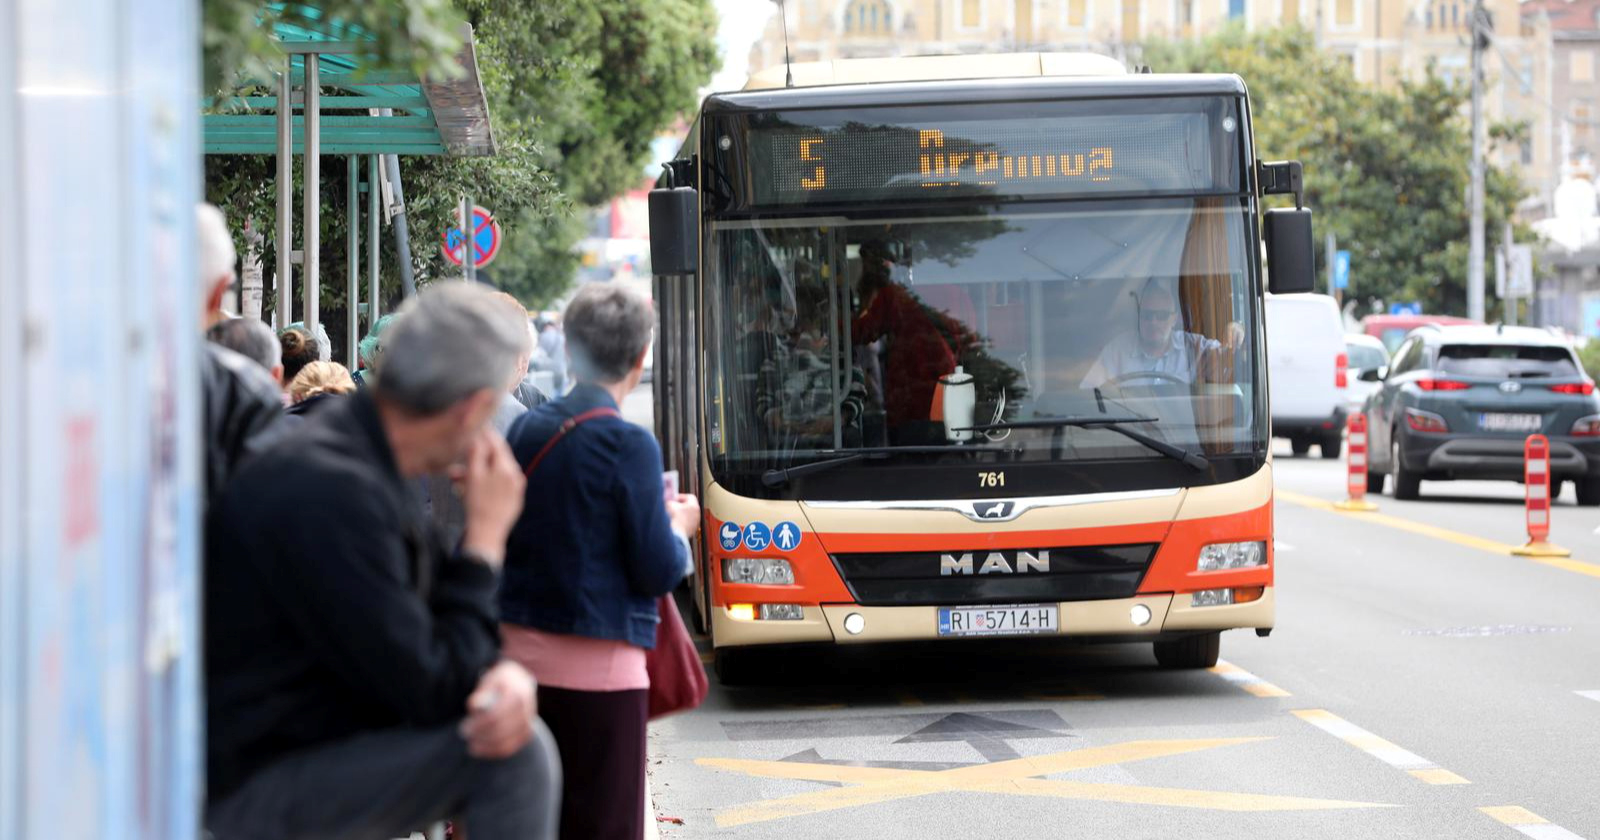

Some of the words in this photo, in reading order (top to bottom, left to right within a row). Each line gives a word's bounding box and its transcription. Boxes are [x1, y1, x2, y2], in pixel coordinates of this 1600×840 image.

[800, 138, 825, 190] 5
[978, 471, 1005, 487] 761
[940, 550, 1050, 576] MAN
[952, 612, 970, 630] RI
[986, 610, 1049, 629] 5714-H
